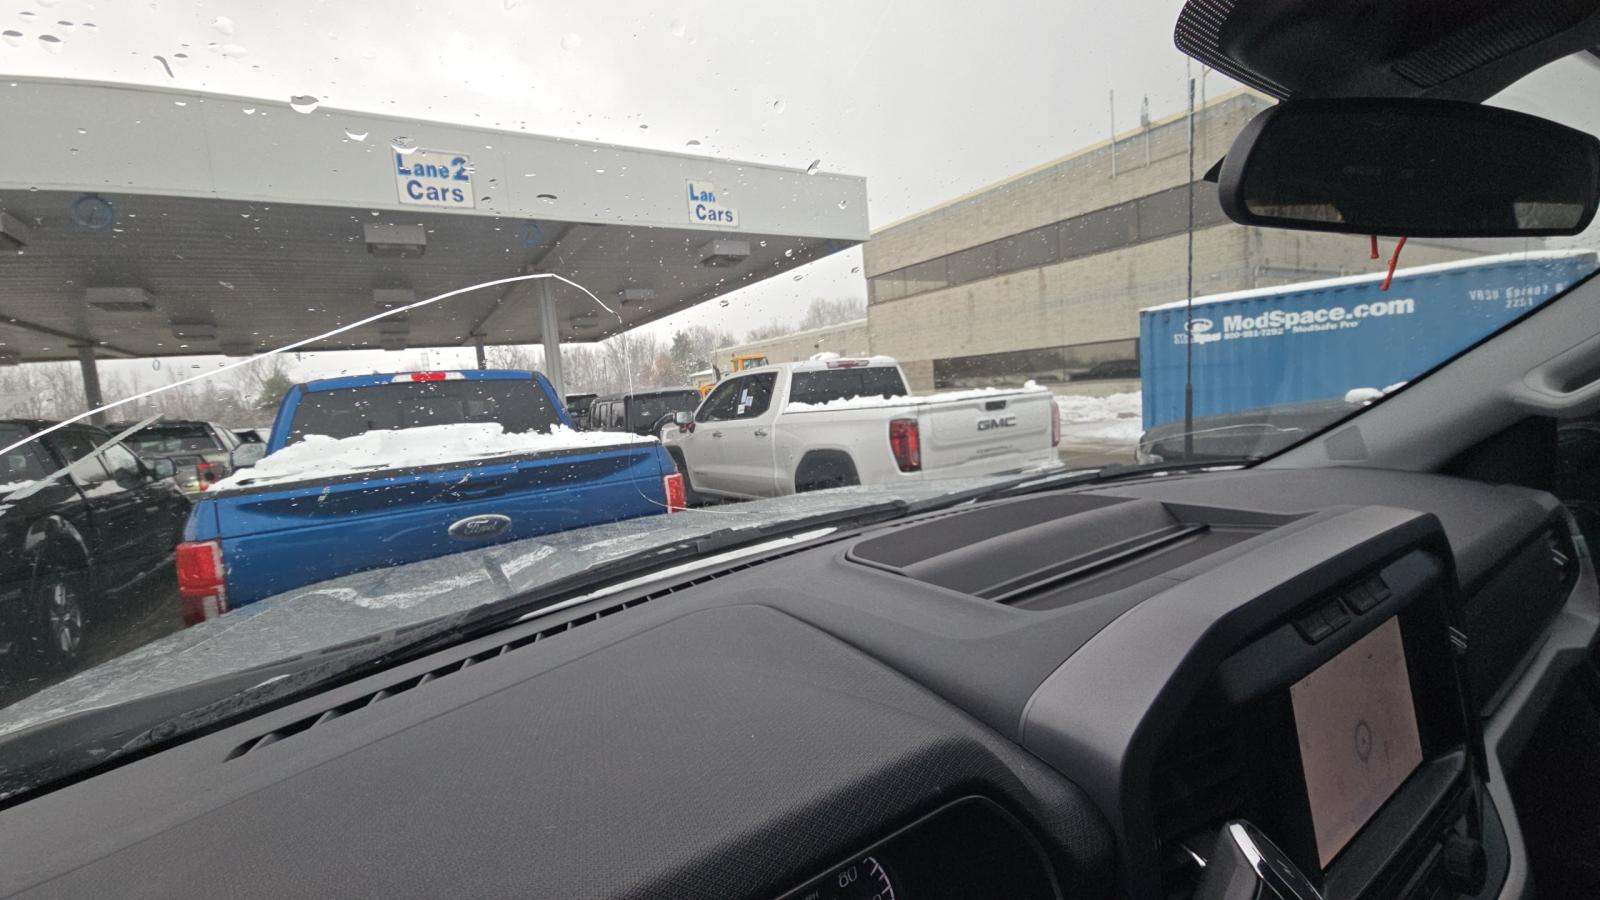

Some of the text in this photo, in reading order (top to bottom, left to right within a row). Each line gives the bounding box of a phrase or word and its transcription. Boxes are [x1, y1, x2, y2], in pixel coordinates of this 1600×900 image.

[396, 152, 469, 181] Lane 2
[406, 179, 464, 203] Cars
[689, 183, 716, 203] Lan
[695, 203, 734, 223] Cars
[1223, 298, 1415, 332] ModSpace.com
[977, 416, 1016, 431] GMC
